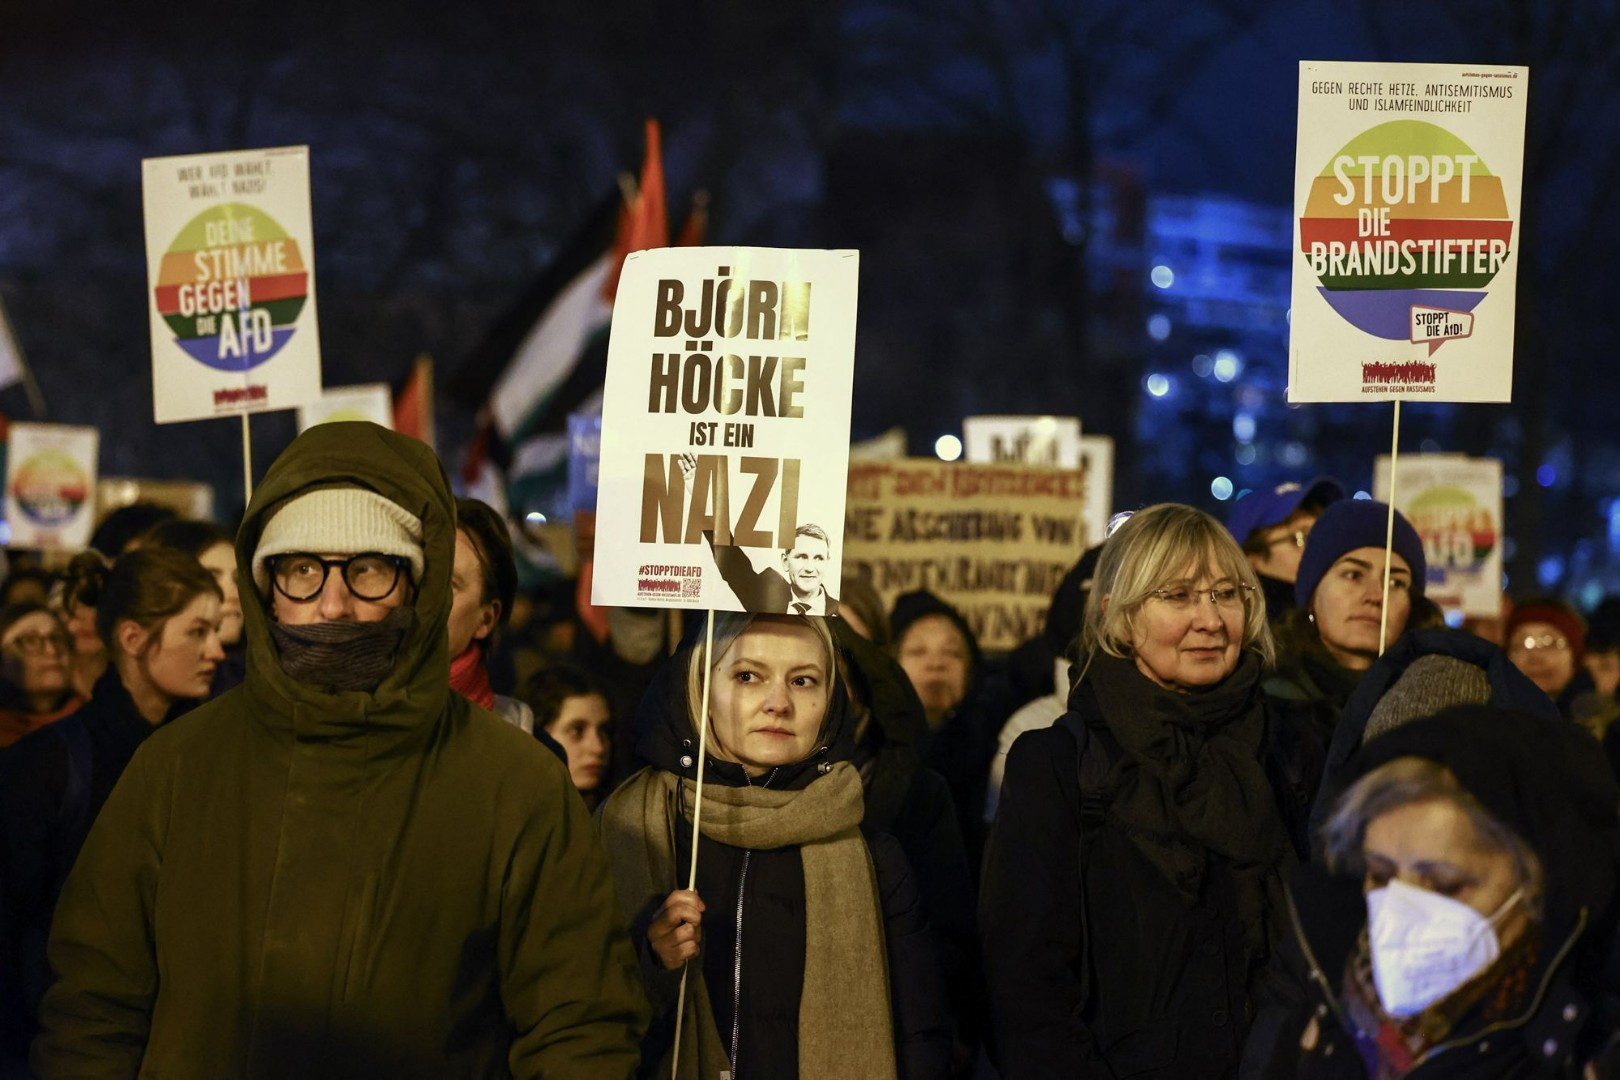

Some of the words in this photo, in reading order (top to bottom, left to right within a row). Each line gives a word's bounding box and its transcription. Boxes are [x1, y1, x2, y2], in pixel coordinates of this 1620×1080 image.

[1312, 82, 1342, 94] GEGEN
[1348, 82, 1383, 96] RECHTE
[1425, 84, 1513, 98] ANTISEMITISMUS
[1349, 98, 1369, 110] UND
[1374, 100, 1472, 112] ISLAMFEINDLICHKEIT
[1333, 154, 1478, 206] STOPPT
[205, 216, 254, 246] DEINE
[1358, 208, 1391, 238] DIE
[194, 240, 287, 282] STIMME
[1310, 238, 1506, 277] BRANDSTIFTER
[178, 277, 251, 318] GEGEN
[654, 266, 812, 342] BJÖRN
[196, 316, 217, 336] DIE
[1416, 312, 1450, 326] STOPPT
[1426, 324, 1440, 336] DIE
[1444, 324, 1463, 336] AfD!
[648, 340, 806, 418] HÖCKE
[689, 422, 718, 446] IST
[724, 422, 754, 448] EIN
[640, 453, 801, 550] NAZI
[638, 564, 702, 578] #STOPPTDIEAFD
